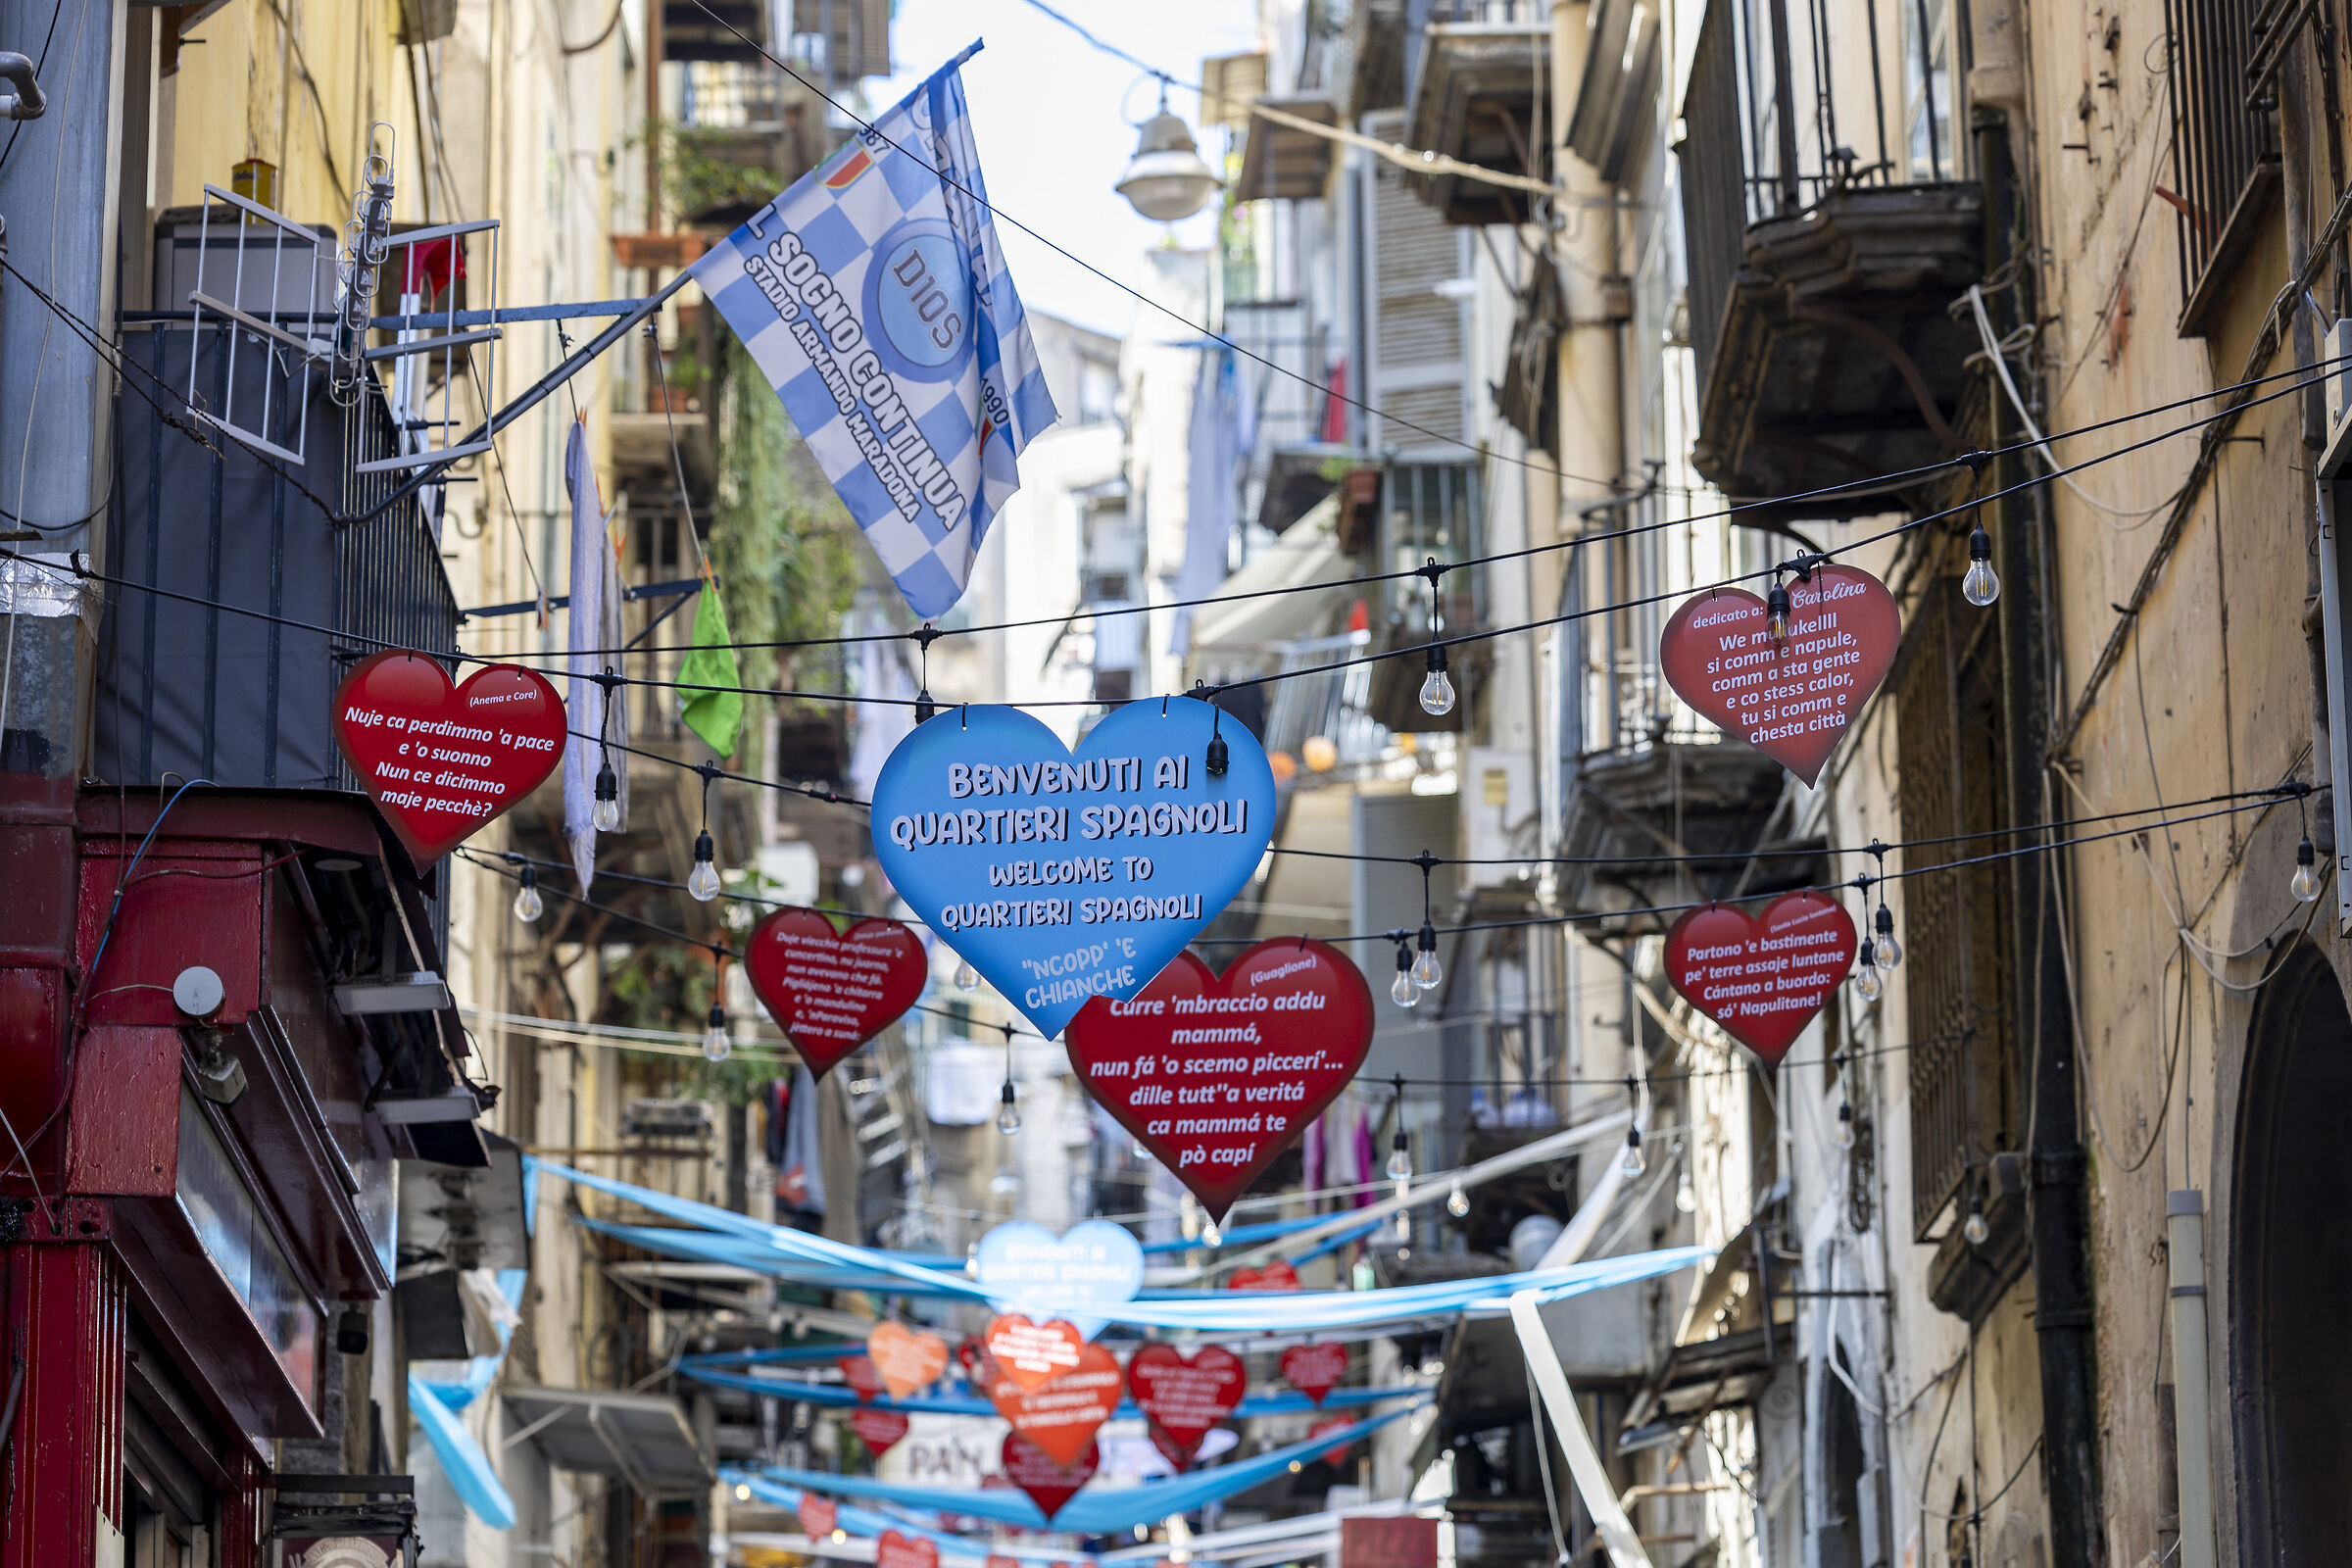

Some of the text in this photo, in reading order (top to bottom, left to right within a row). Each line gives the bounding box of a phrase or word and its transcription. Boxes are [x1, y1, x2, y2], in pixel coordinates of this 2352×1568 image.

[744, 255, 921, 522] STADIO ARMANDO MARADONA
[768, 231, 862, 353] SOGNO
[851, 350, 965, 531] CONTINUA
[981, 377, 1009, 424] 1990
[1692, 581, 1867, 629] dedicato a: Carolina
[1706, 632, 1858, 674] si comm e napule,
[1719, 634, 1746, 652] We
[1711, 650, 1861, 693] comm a sta gente
[469, 694, 505, 708] (Anema
[514, 689, 537, 702] Core)
[1726, 672, 1854, 710] e co stess calor,
[1741, 693, 1847, 726] tu si comm e
[345, 707, 555, 752] Nuje ca perdimmo 'a pace
[1749, 710, 1846, 745] chesta città
[399, 741, 492, 767] e 'o suonno
[375, 761, 506, 795] Nun ce dicimmo
[948, 755, 1189, 798] BENVENUTI AI
[380, 789, 493, 817] maje pecchè?
[890, 799, 1248, 852] QUARTIERI SPAGNOLI
[989, 857, 1153, 887] WELCOME TO
[941, 894, 1203, 931] QUARTIERI SPAGNOLI
[1115, 938, 1137, 958] 'E
[1688, 929, 1838, 962] Partono 'e bastimente
[1250, 955, 1317, 987] (Guaglione)
[1685, 951, 1844, 986] pe' terre assaje luntane
[1025, 965, 1136, 1008] CHIANCHE
[1703, 972, 1831, 1001] Cántano a buordo:
[1110, 991, 1325, 1016] Curre 'mbraccio addu
[1740, 991, 1822, 1017] Napulitane!
[1171, 1022, 1262, 1046] mammá,
[1091, 1060, 1129, 1077] nun
[1161, 1054, 1179, 1075] 'o
[1183, 1056, 1249, 1074] scemo
[1129, 1085, 1173, 1105] dille
[1147, 1112, 1287, 1135] ca mammá te
[1179, 1144, 1206, 1168] pò
